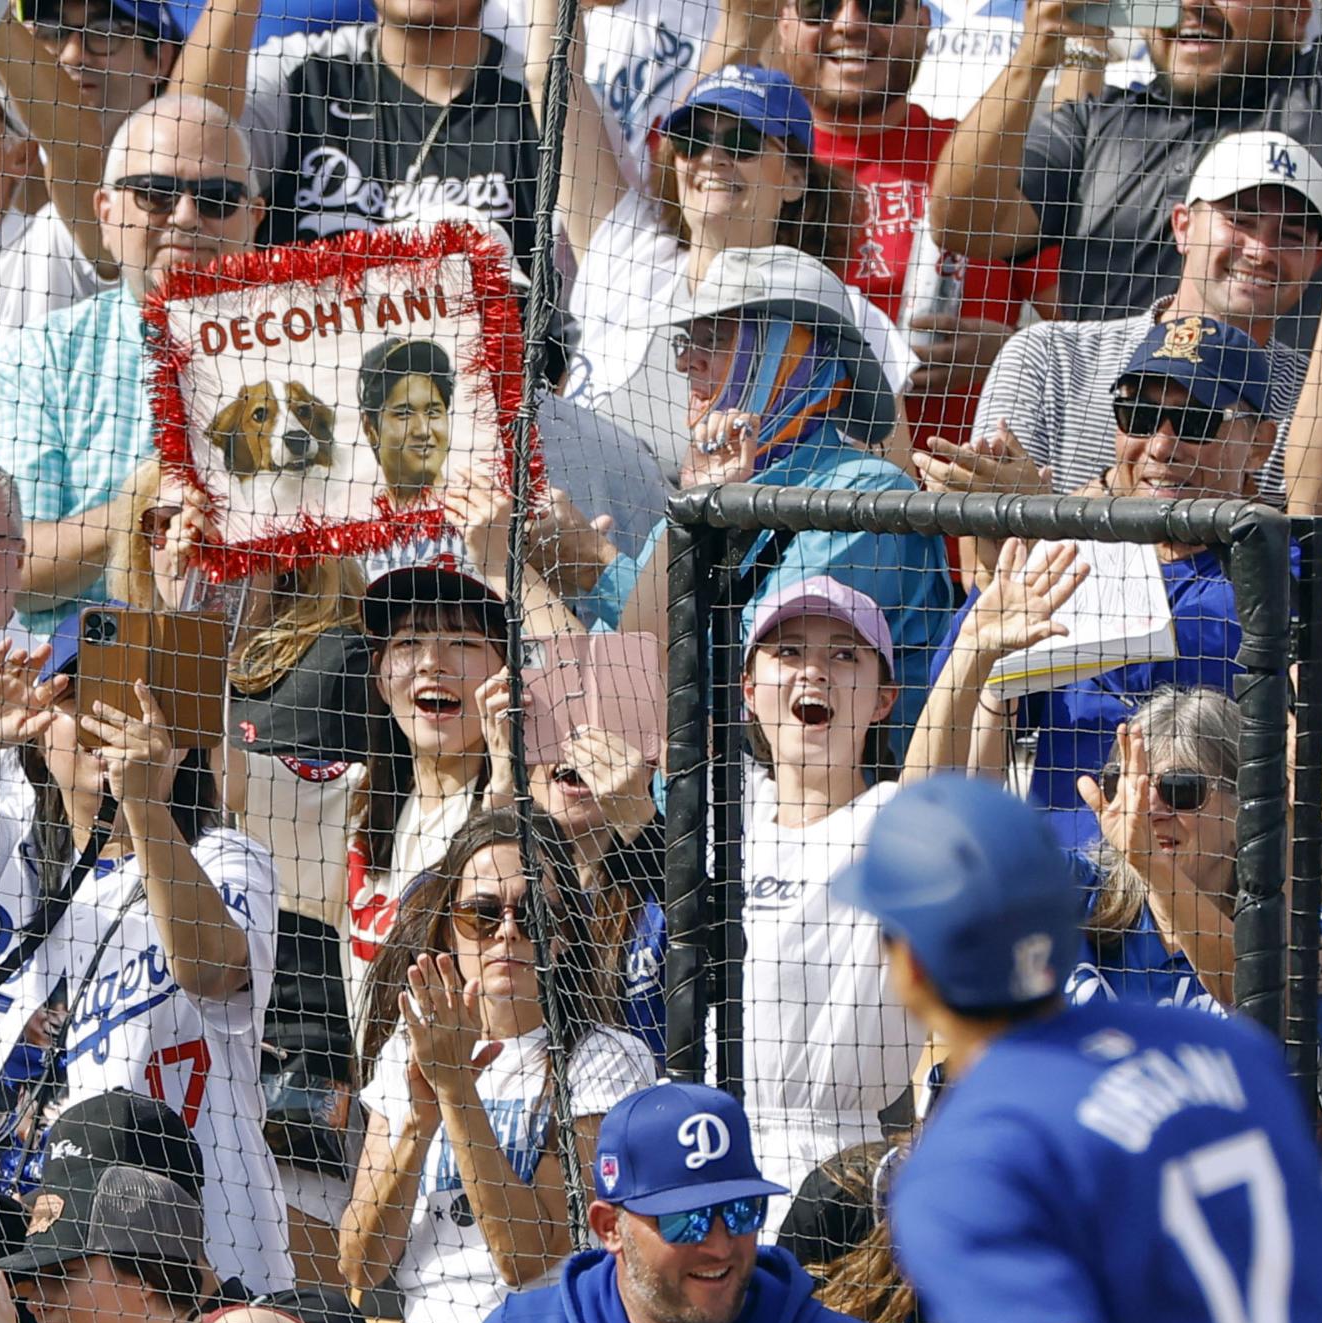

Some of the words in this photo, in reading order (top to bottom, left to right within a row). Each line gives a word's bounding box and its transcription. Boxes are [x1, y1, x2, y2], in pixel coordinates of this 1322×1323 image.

[1266, 141, 1297, 180] LA
[199, 284, 448, 356] DECOHTANI
[145, 1039, 212, 1130] 17
[678, 1113, 730, 1169] D
